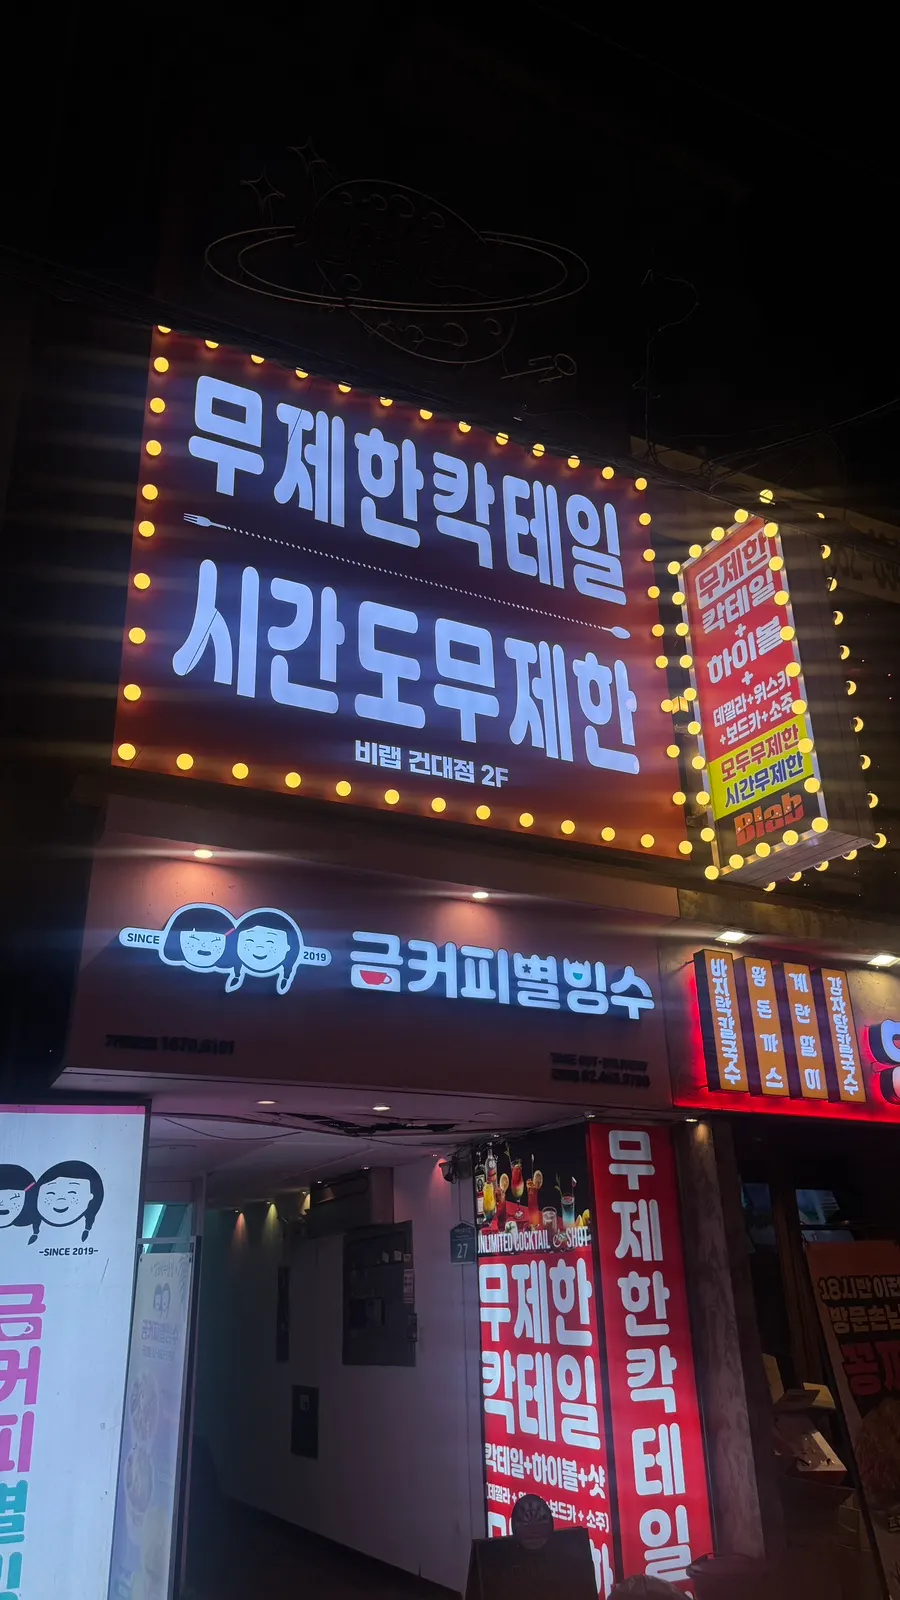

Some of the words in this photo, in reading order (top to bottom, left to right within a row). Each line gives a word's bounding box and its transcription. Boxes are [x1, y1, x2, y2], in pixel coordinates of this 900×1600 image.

[188, 375, 627, 606] 무제한칵테일
[698, 531, 769, 599] 무제한
[702, 567, 776, 634] 칵테일
[172, 558, 640, 776] 시간도무제한
[707, 615, 783, 684] 하이볼
[355, 740, 401, 770] 비랩
[409, 750, 475, 783] 건대점
[481, 765, 508, 788] 2F
[720, 723, 800, 783] 모두무제한
[725, 751, 804, 808] 시간무제한
[127, 932, 160, 945] SINCE
[303, 951, 327, 962] 2019
[711, 957, 741, 1085] 바지락칼국수
[751, 966, 784, 1089] 왕돈까스
[788, 972, 821, 1090] 계란말이
[456, 1243, 468, 1260] 27
[514, 1229, 550, 1252] COCKTAIL
[566, 1226, 592, 1247] SHOT
[478, 1257, 593, 1347] 무제한
[481, 1349, 601, 1450] 칵테일
